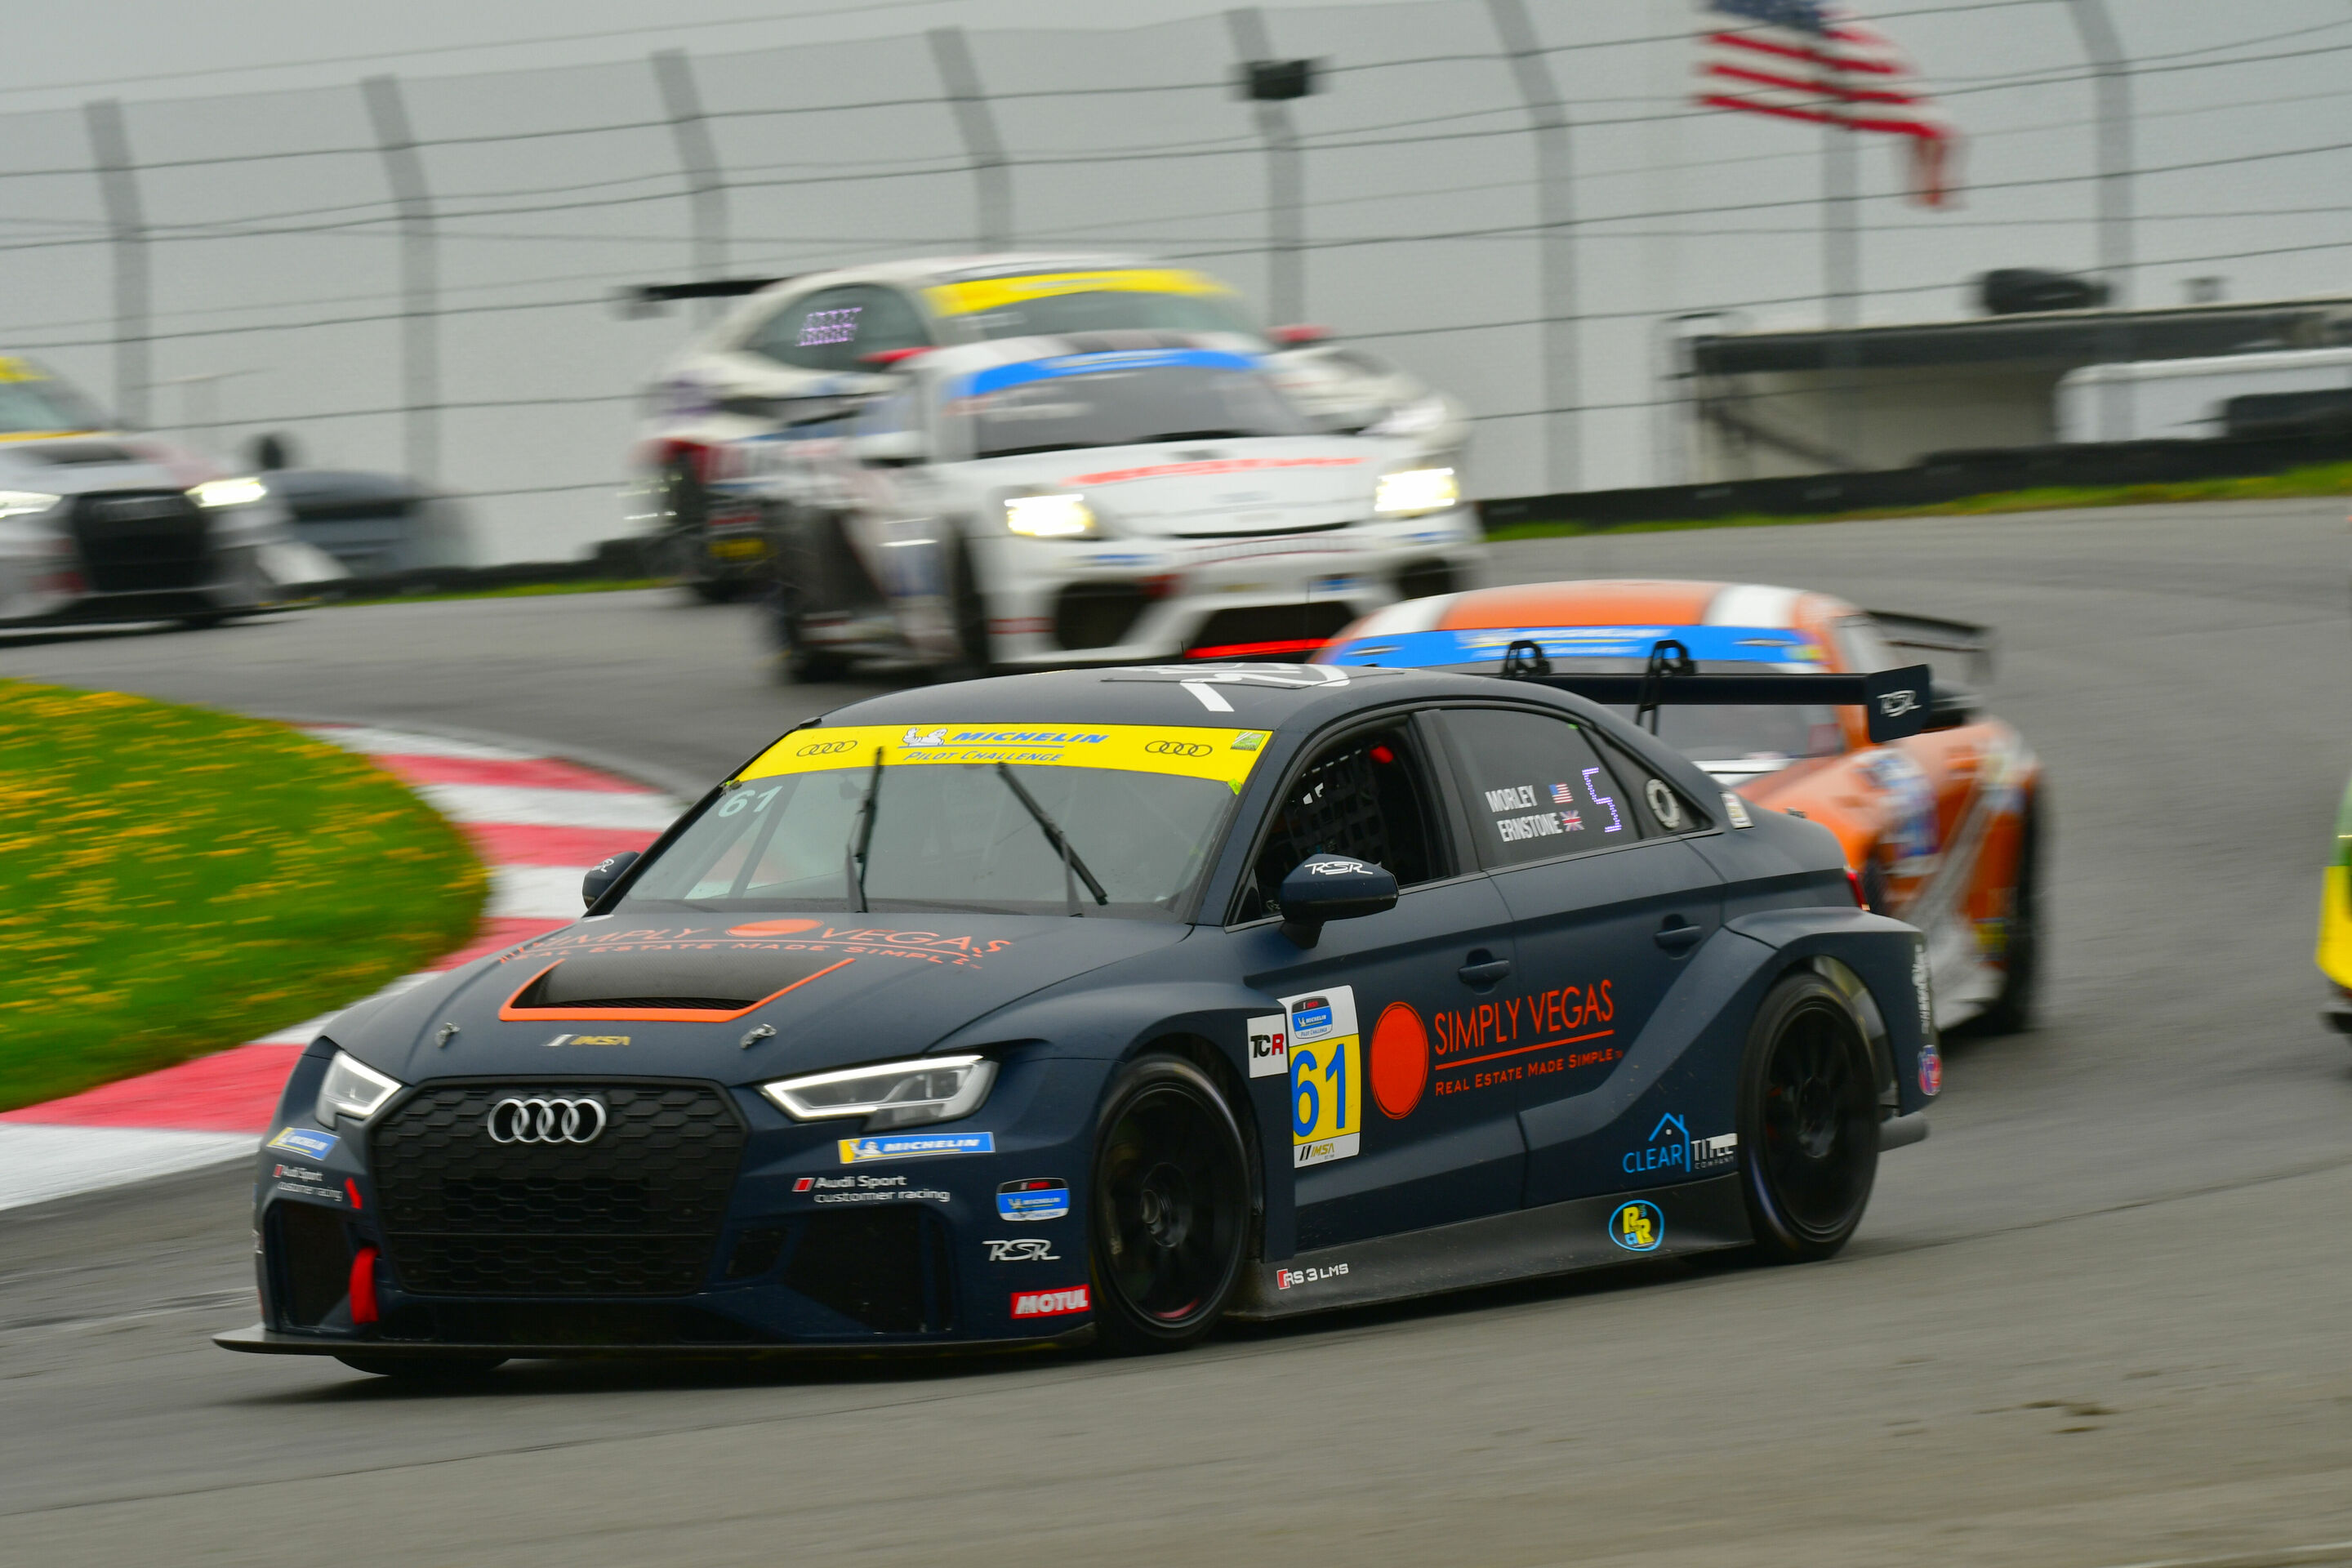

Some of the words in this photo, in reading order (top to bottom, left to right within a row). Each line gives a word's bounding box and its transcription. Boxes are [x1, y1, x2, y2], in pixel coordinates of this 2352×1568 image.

[950, 732, 1110, 744] MICHELIN
[902, 751, 959, 761] PILOT
[960, 750, 1064, 762] CHALLENGE
[719, 786, 783, 817] 61
[1485, 785, 1538, 813] MORLEY
[1496, 813, 1564, 842] ERNSTONE
[731, 942, 831, 951] MADE
[821, 929, 1012, 957] VEGAS
[1434, 996, 1521, 1055] SIMPLY
[1526, 979, 1615, 1035] VEGAS
[1250, 1033, 1285, 1058] TCR
[1435, 1079, 1470, 1097] REAL
[1474, 1067, 1523, 1089] ESTATE
[1527, 1058, 1565, 1077] MADE
[1568, 1048, 1615, 1069] SIMPLE
[1290, 1043, 1347, 1138] 61
[883, 1139, 980, 1152] MICHELIN
[1310, 1143, 1335, 1157] IMSA
[1622, 1144, 1683, 1174] CLEAR
[814, 1176, 856, 1188] Audi
[858, 1174, 907, 1190] Sport
[813, 1190, 895, 1203] customer
[898, 1189, 951, 1202] racing
[1283, 1270, 1304, 1287] RS
[1306, 1267, 1318, 1282] 3
[1320, 1263, 1349, 1279] LMS
[1015, 1289, 1089, 1315] MOTUL
